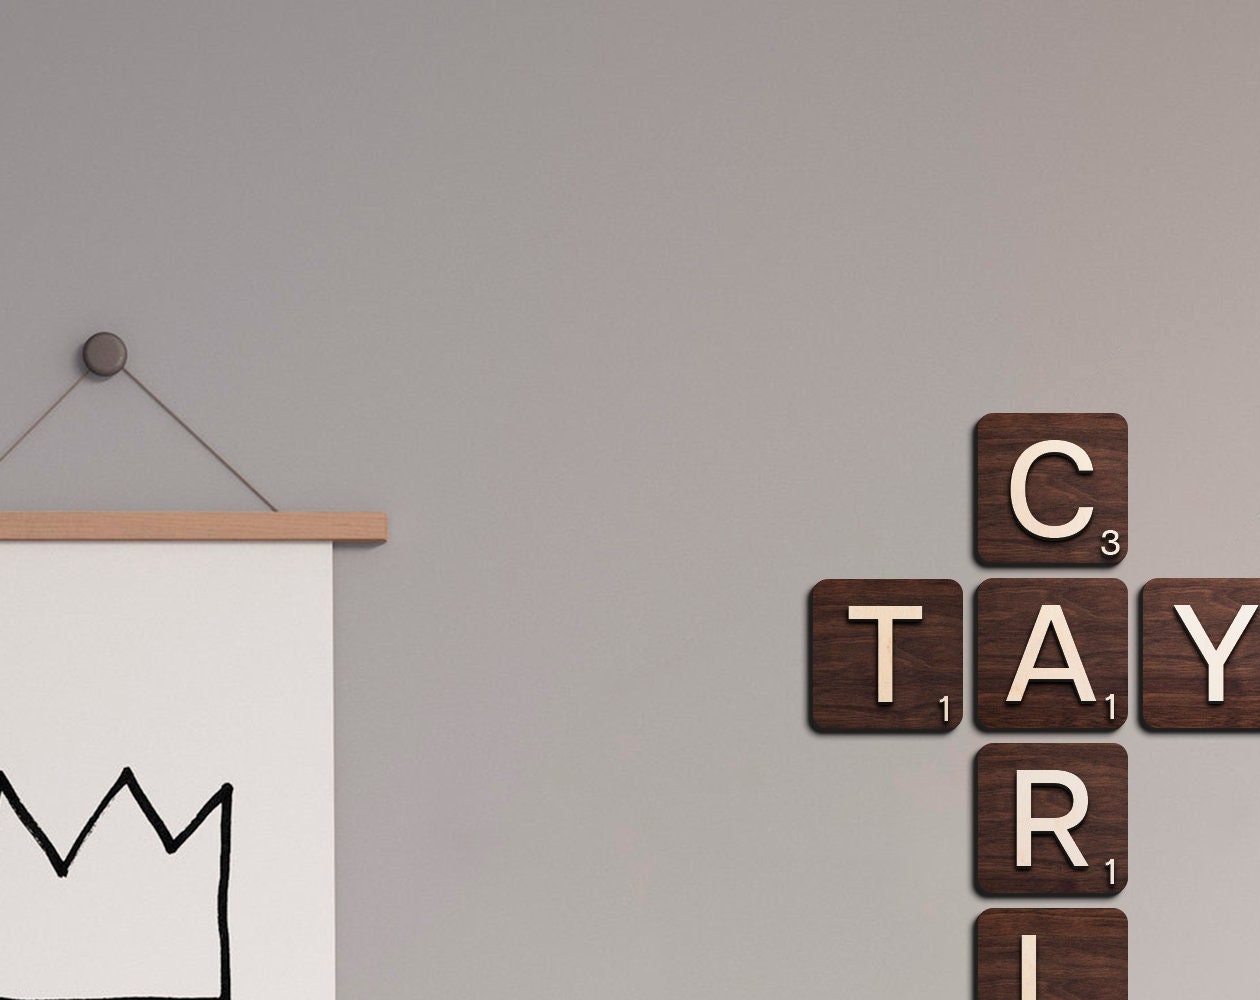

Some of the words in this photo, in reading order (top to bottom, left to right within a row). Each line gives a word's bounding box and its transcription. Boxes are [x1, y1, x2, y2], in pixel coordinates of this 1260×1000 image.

[1099, 529, 1119, 556] 3
[938, 694, 949, 722] 1
[1104, 693, 1115, 720] 1
[1104, 858, 1115, 885] 1
